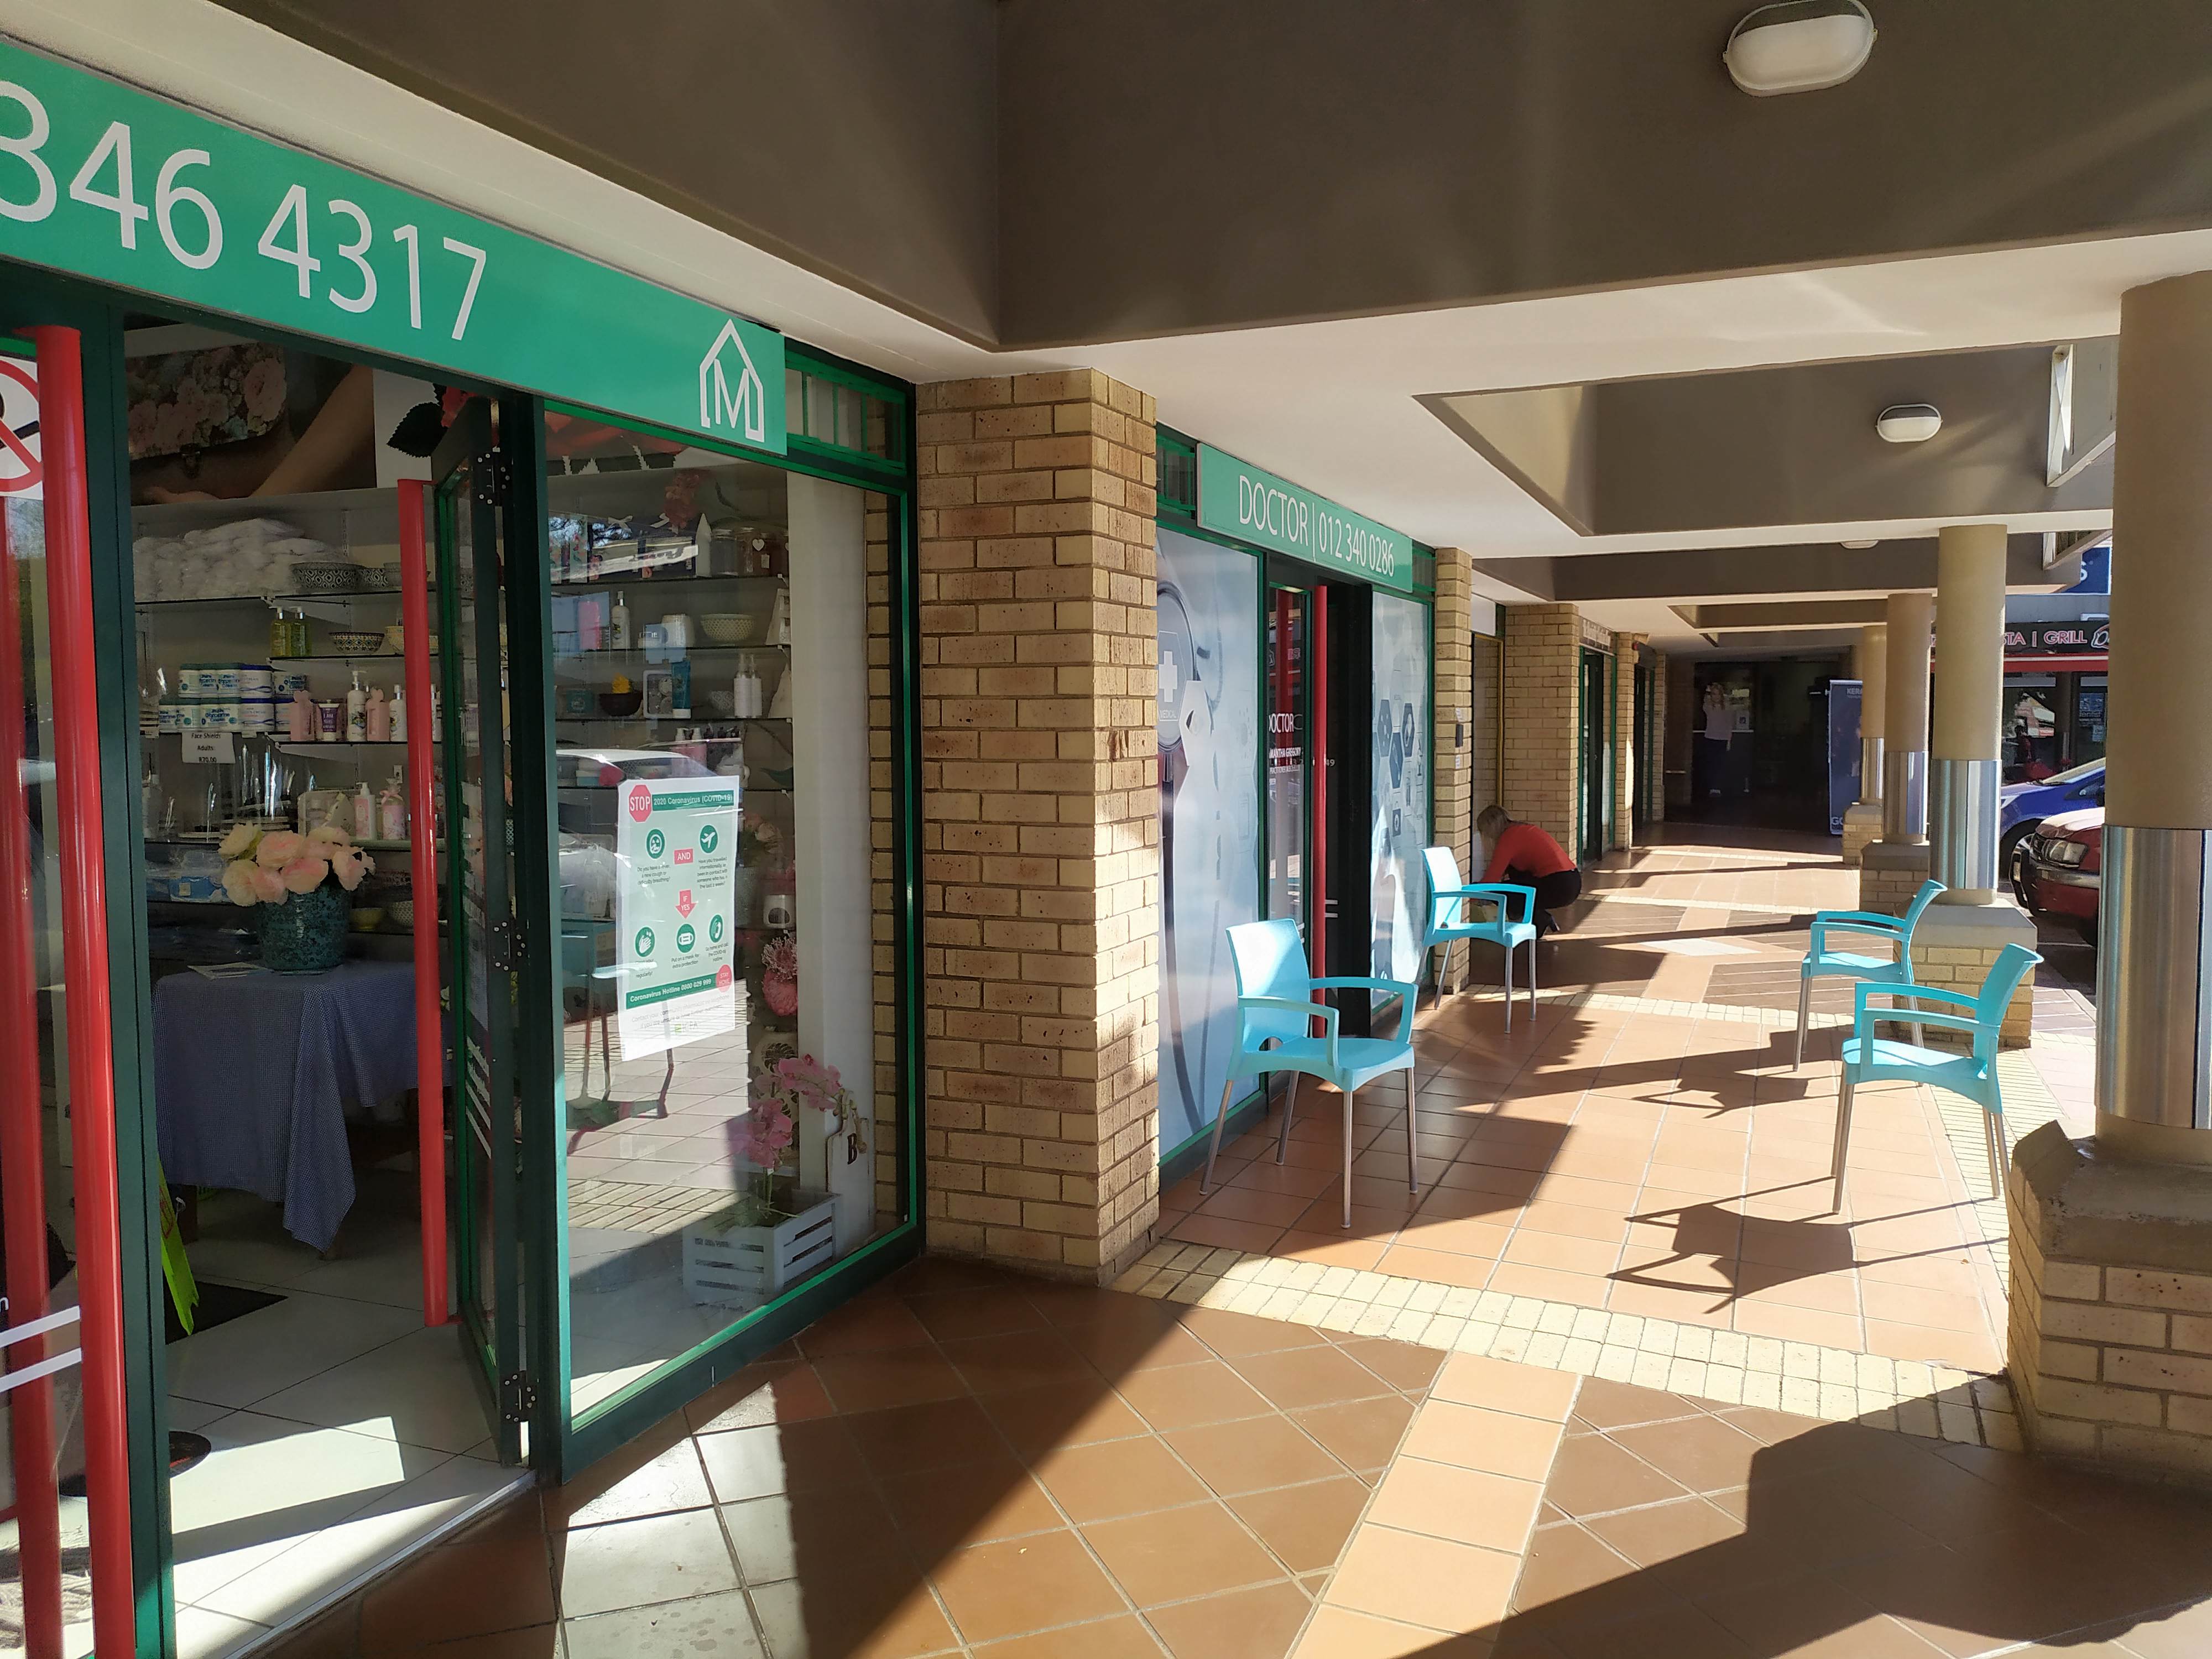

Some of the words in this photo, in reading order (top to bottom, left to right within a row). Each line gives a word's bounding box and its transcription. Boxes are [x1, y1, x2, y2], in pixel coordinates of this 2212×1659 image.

[0, 80, 223, 270] 346
[258, 184, 487, 341] 4317
[1239, 475, 1308, 546] DOCTOR
[1319, 512, 1342, 559] 012
[1345, 523, 1366, 567] 340
[1369, 534, 1394, 577] 0286
[2043, 630, 2088, 645] GRILL
[629, 796, 650, 811] STOP
[667, 796, 701, 805] Coronavirus
[702, 794, 733, 803] (COVID-19)
[677, 852, 691, 861] AND
[630, 990, 661, 1003] Coronavirus
[662, 987, 681, 995] Hotline
[847, 1133, 858, 1165] B
